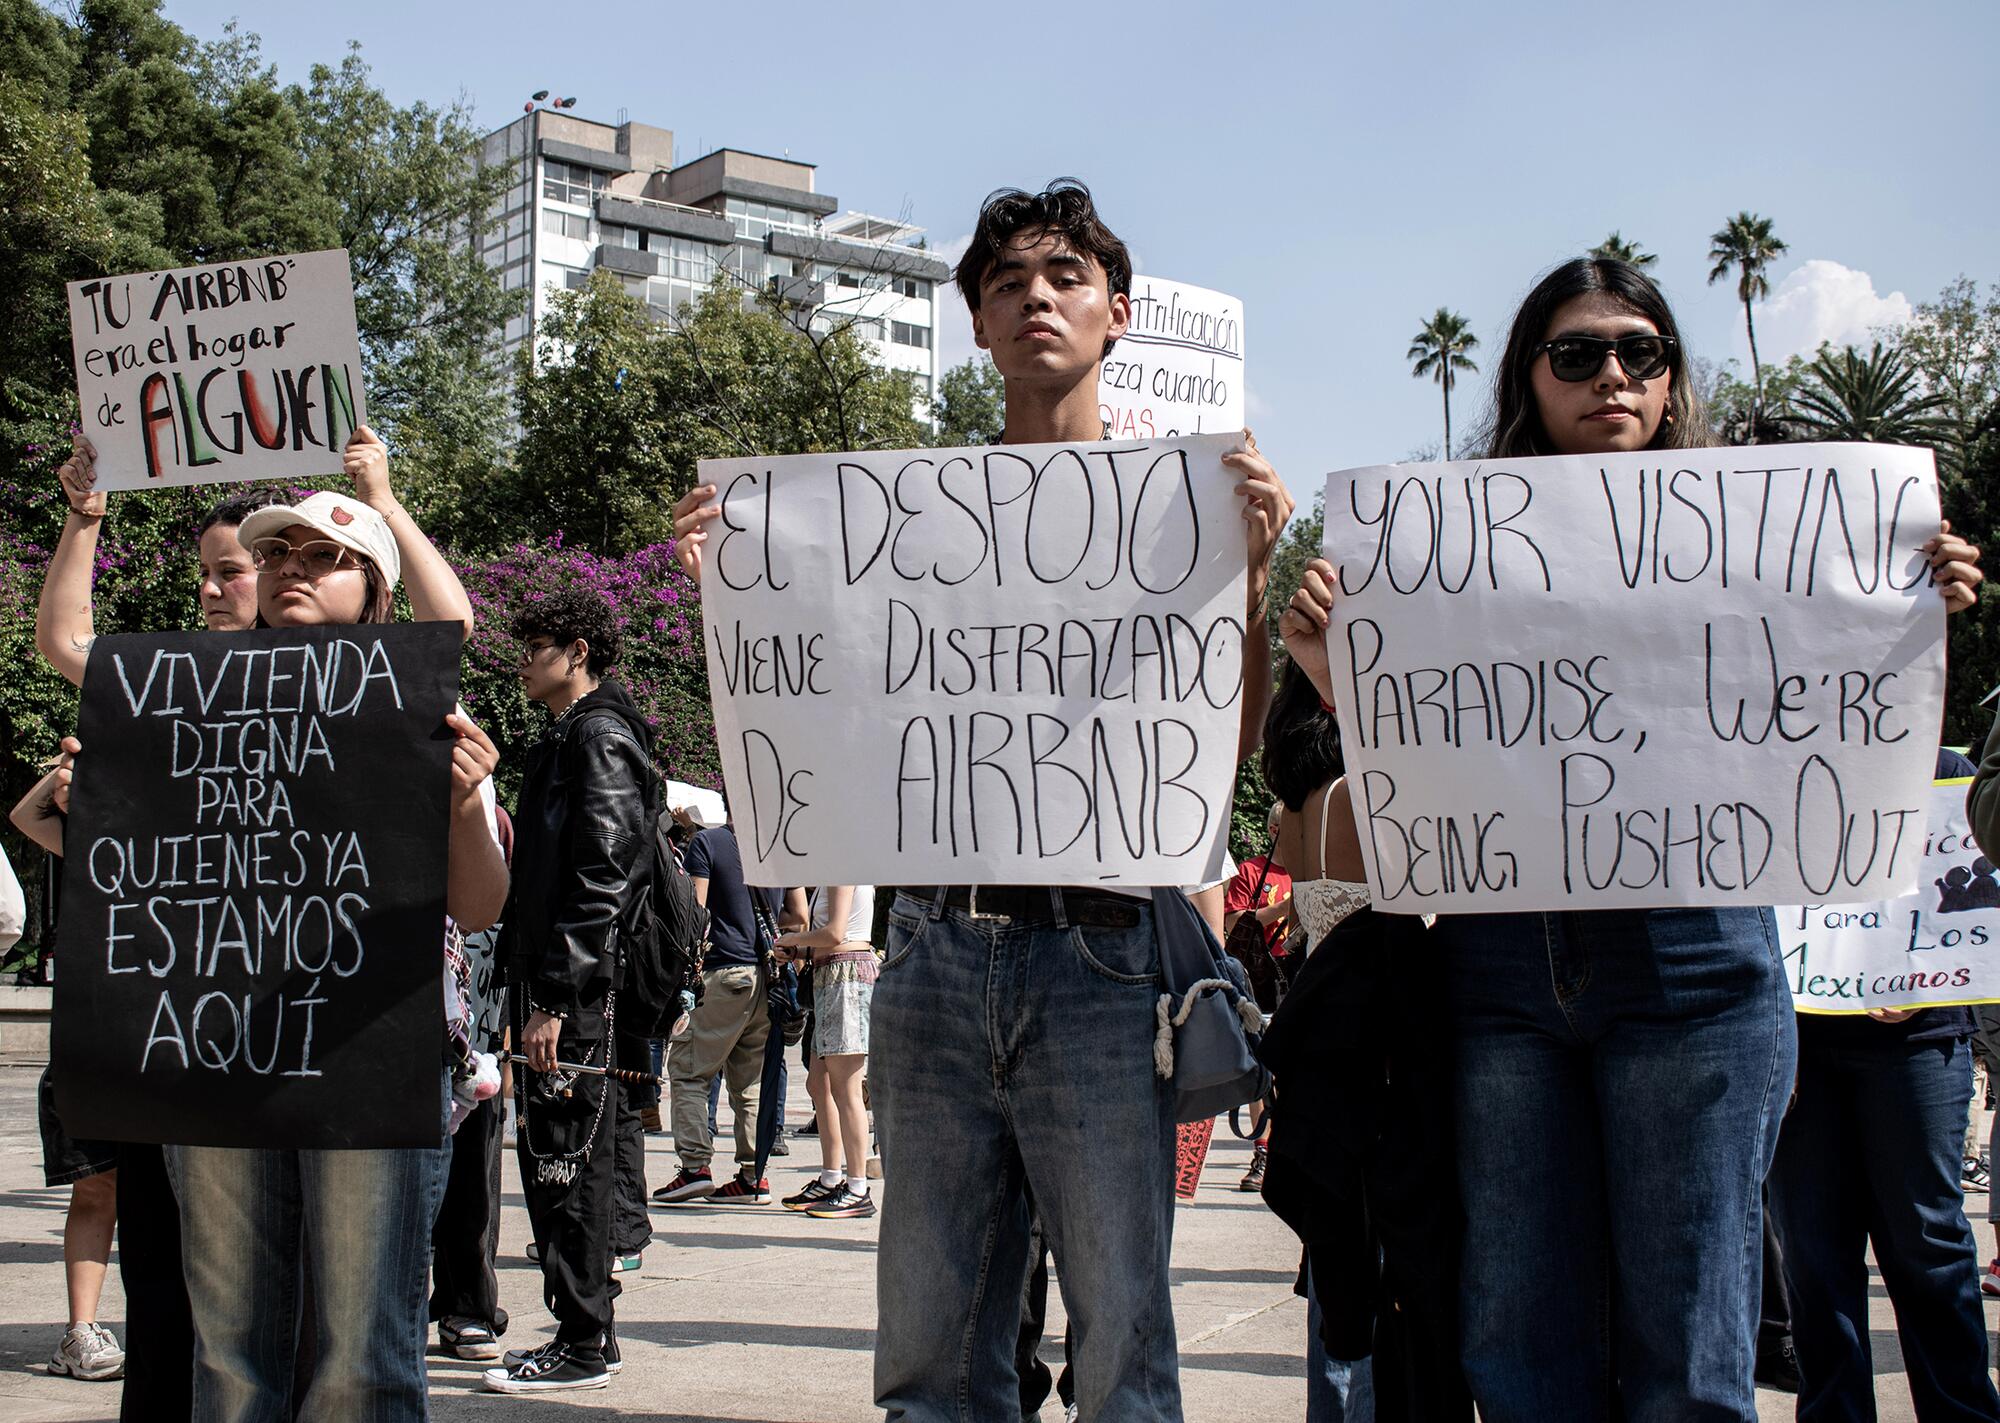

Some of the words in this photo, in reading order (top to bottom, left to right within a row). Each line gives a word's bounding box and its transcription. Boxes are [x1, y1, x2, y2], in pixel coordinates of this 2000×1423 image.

[80, 281, 132, 335] TU
[1129, 283, 1238, 353] ntrificación
[83, 342, 145, 379] era
[146, 325, 180, 364] el
[186, 320, 297, 368] hogar
[1152, 357, 1227, 407] cuando
[96, 392, 126, 428] de
[139, 363, 358, 479] ALGUIEN
[836, 447, 1200, 595] DESPOJO
[111, 638, 405, 718] VIVIENDA
[710, 618, 834, 700] VIENE
[1343, 616, 1650, 755] PARADISE,
[168, 714, 336, 779] DIGNA
[196, 775, 296, 829] PARA
[740, 727, 818, 866] DE
[895, 708, 1212, 866] AIRBNB
[1359, 766, 1522, 904] BEING
[1558, 748, 1775, 897] PUSHED
[1792, 750, 1922, 899] OUT
[87, 830, 310, 899] QUIENES
[318, 828, 372, 890] YA
[105, 893, 371, 977] ESTAMOS
[1905, 909, 1990, 953] Los
[138, 975, 330, 1078] AQUÍ
